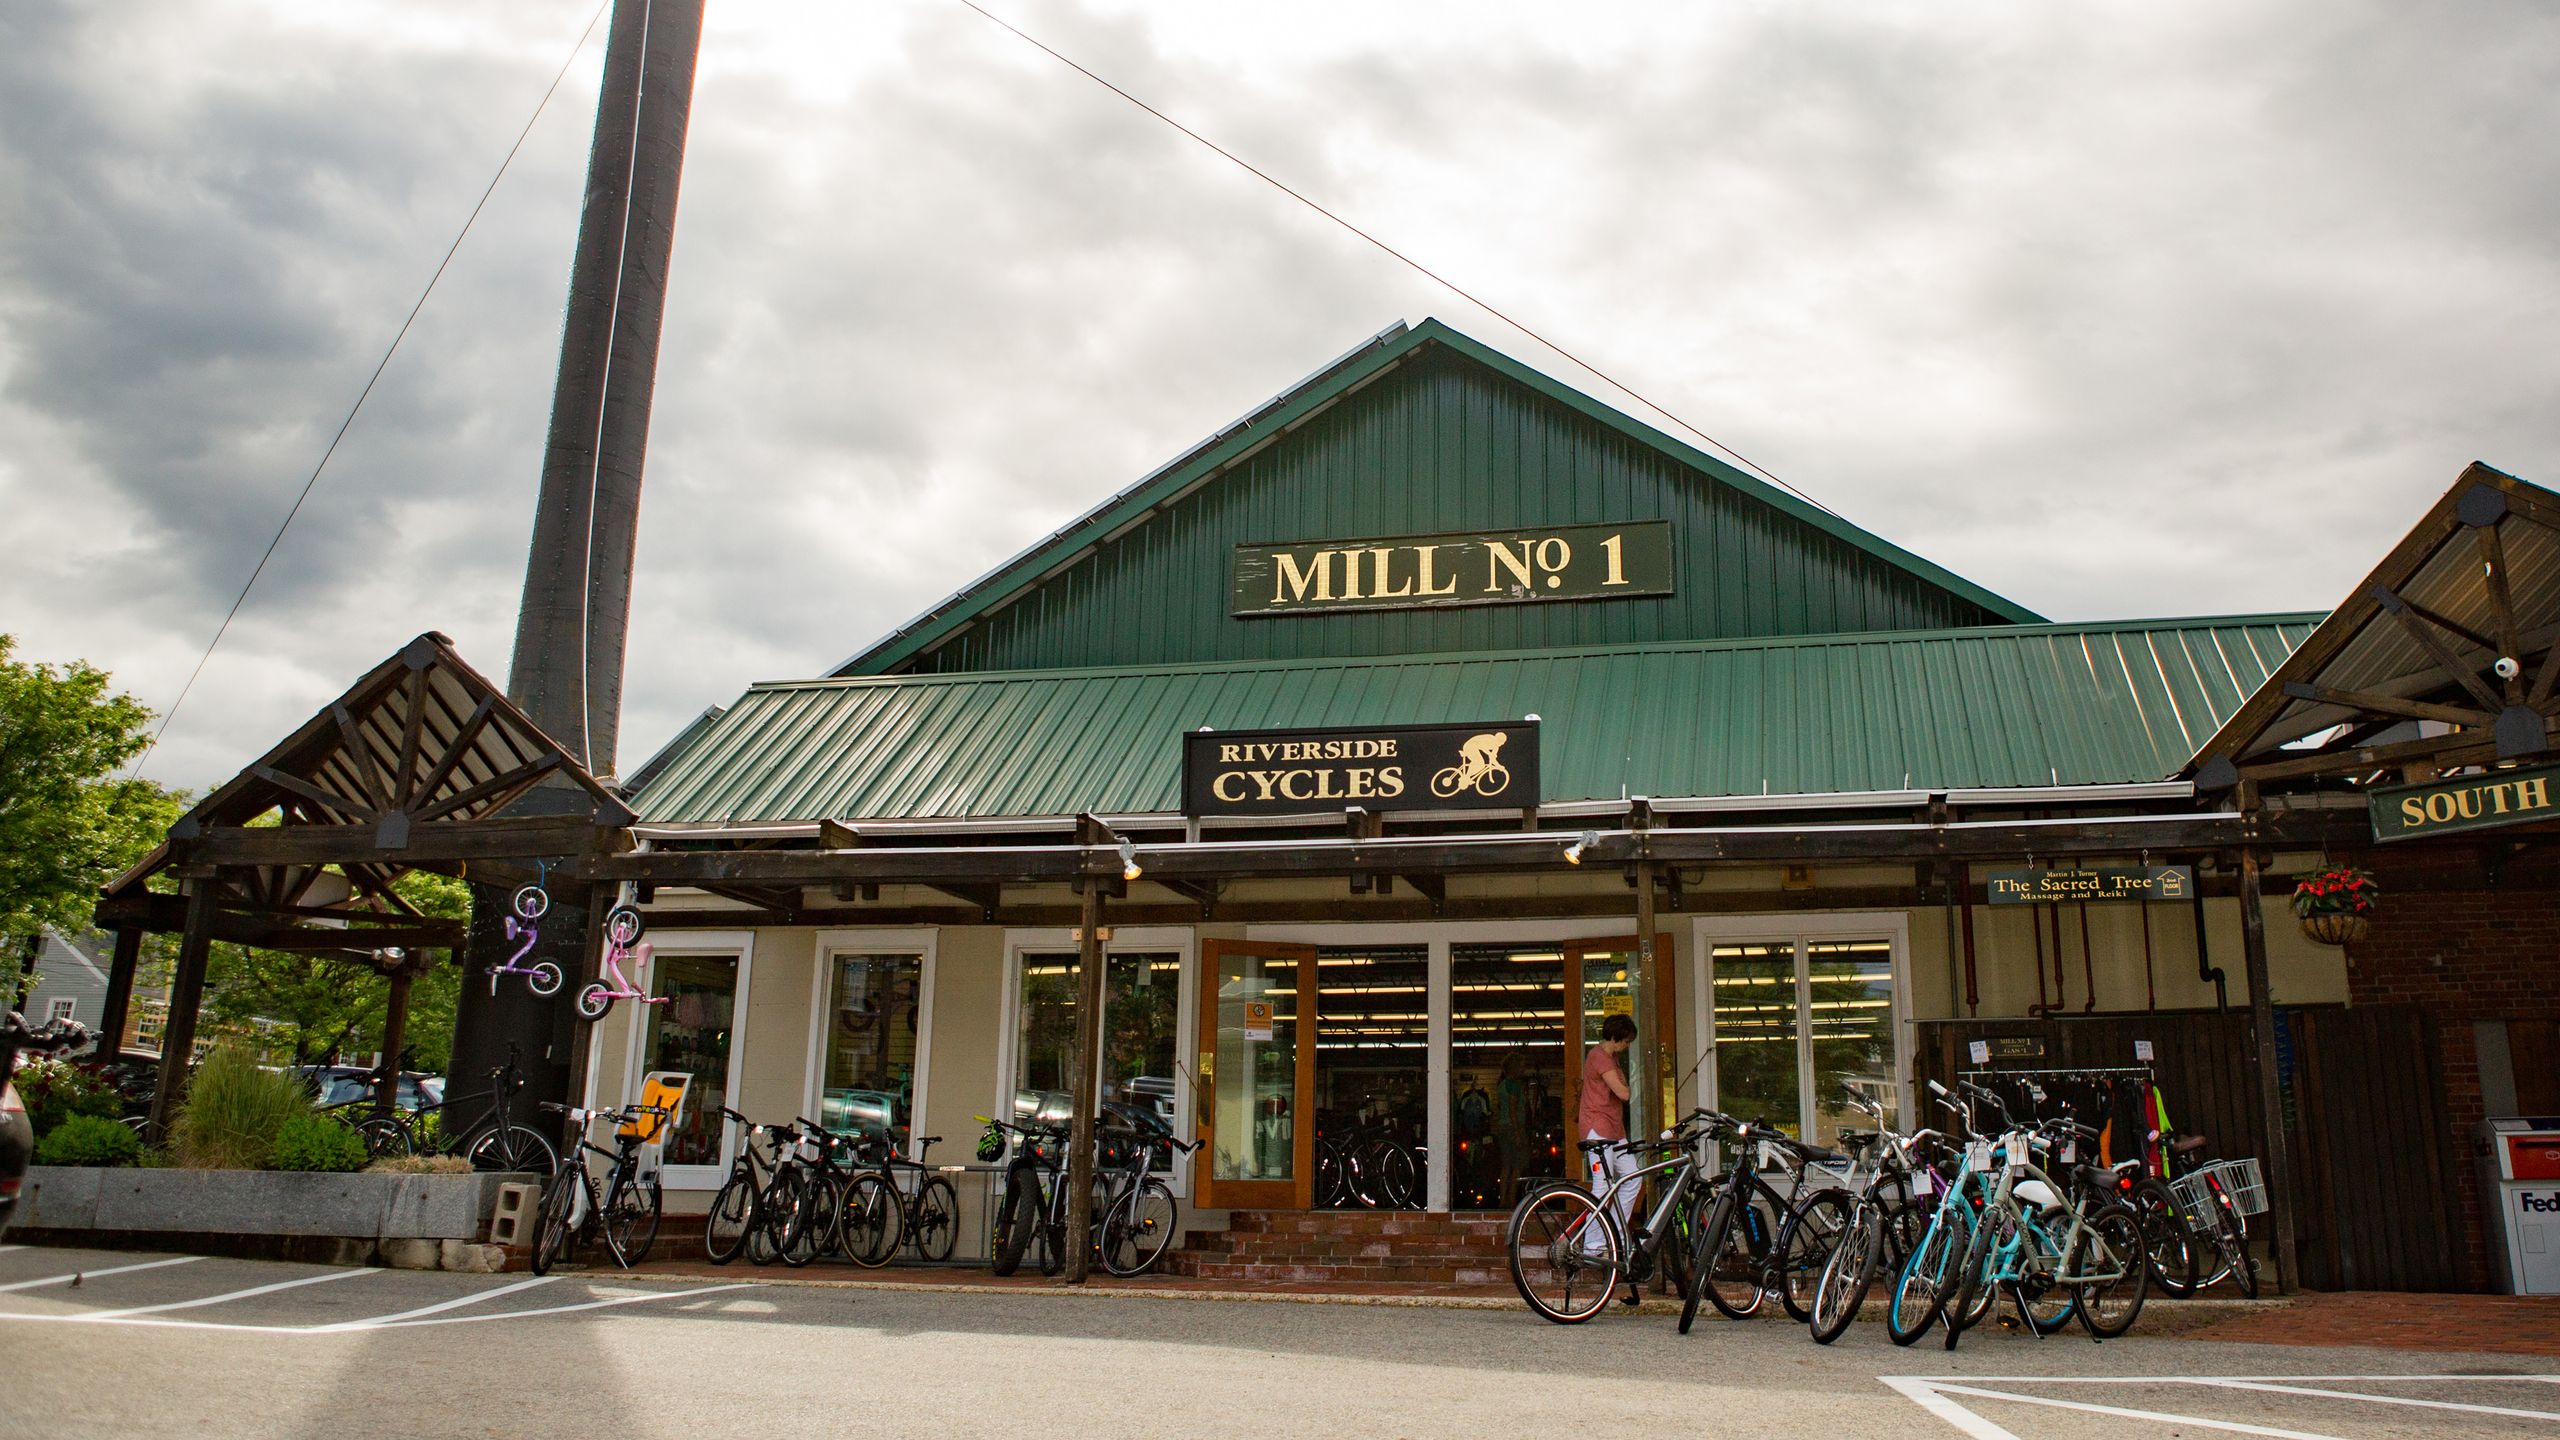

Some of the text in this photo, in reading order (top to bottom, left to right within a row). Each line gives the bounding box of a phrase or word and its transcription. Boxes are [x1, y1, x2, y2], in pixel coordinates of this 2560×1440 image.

[1270, 546, 1456, 602] MILL
[1600, 534, 1630, 586] 1
[1219, 739, 1398, 763] RIVERSIDE
[1212, 766, 1405, 802] CYCLES
[2401, 777, 2552, 828] SOUTH
[1994, 875, 2153, 893] The Sacred Tree
[2020, 890, 2127, 901] Massage and Reiki
